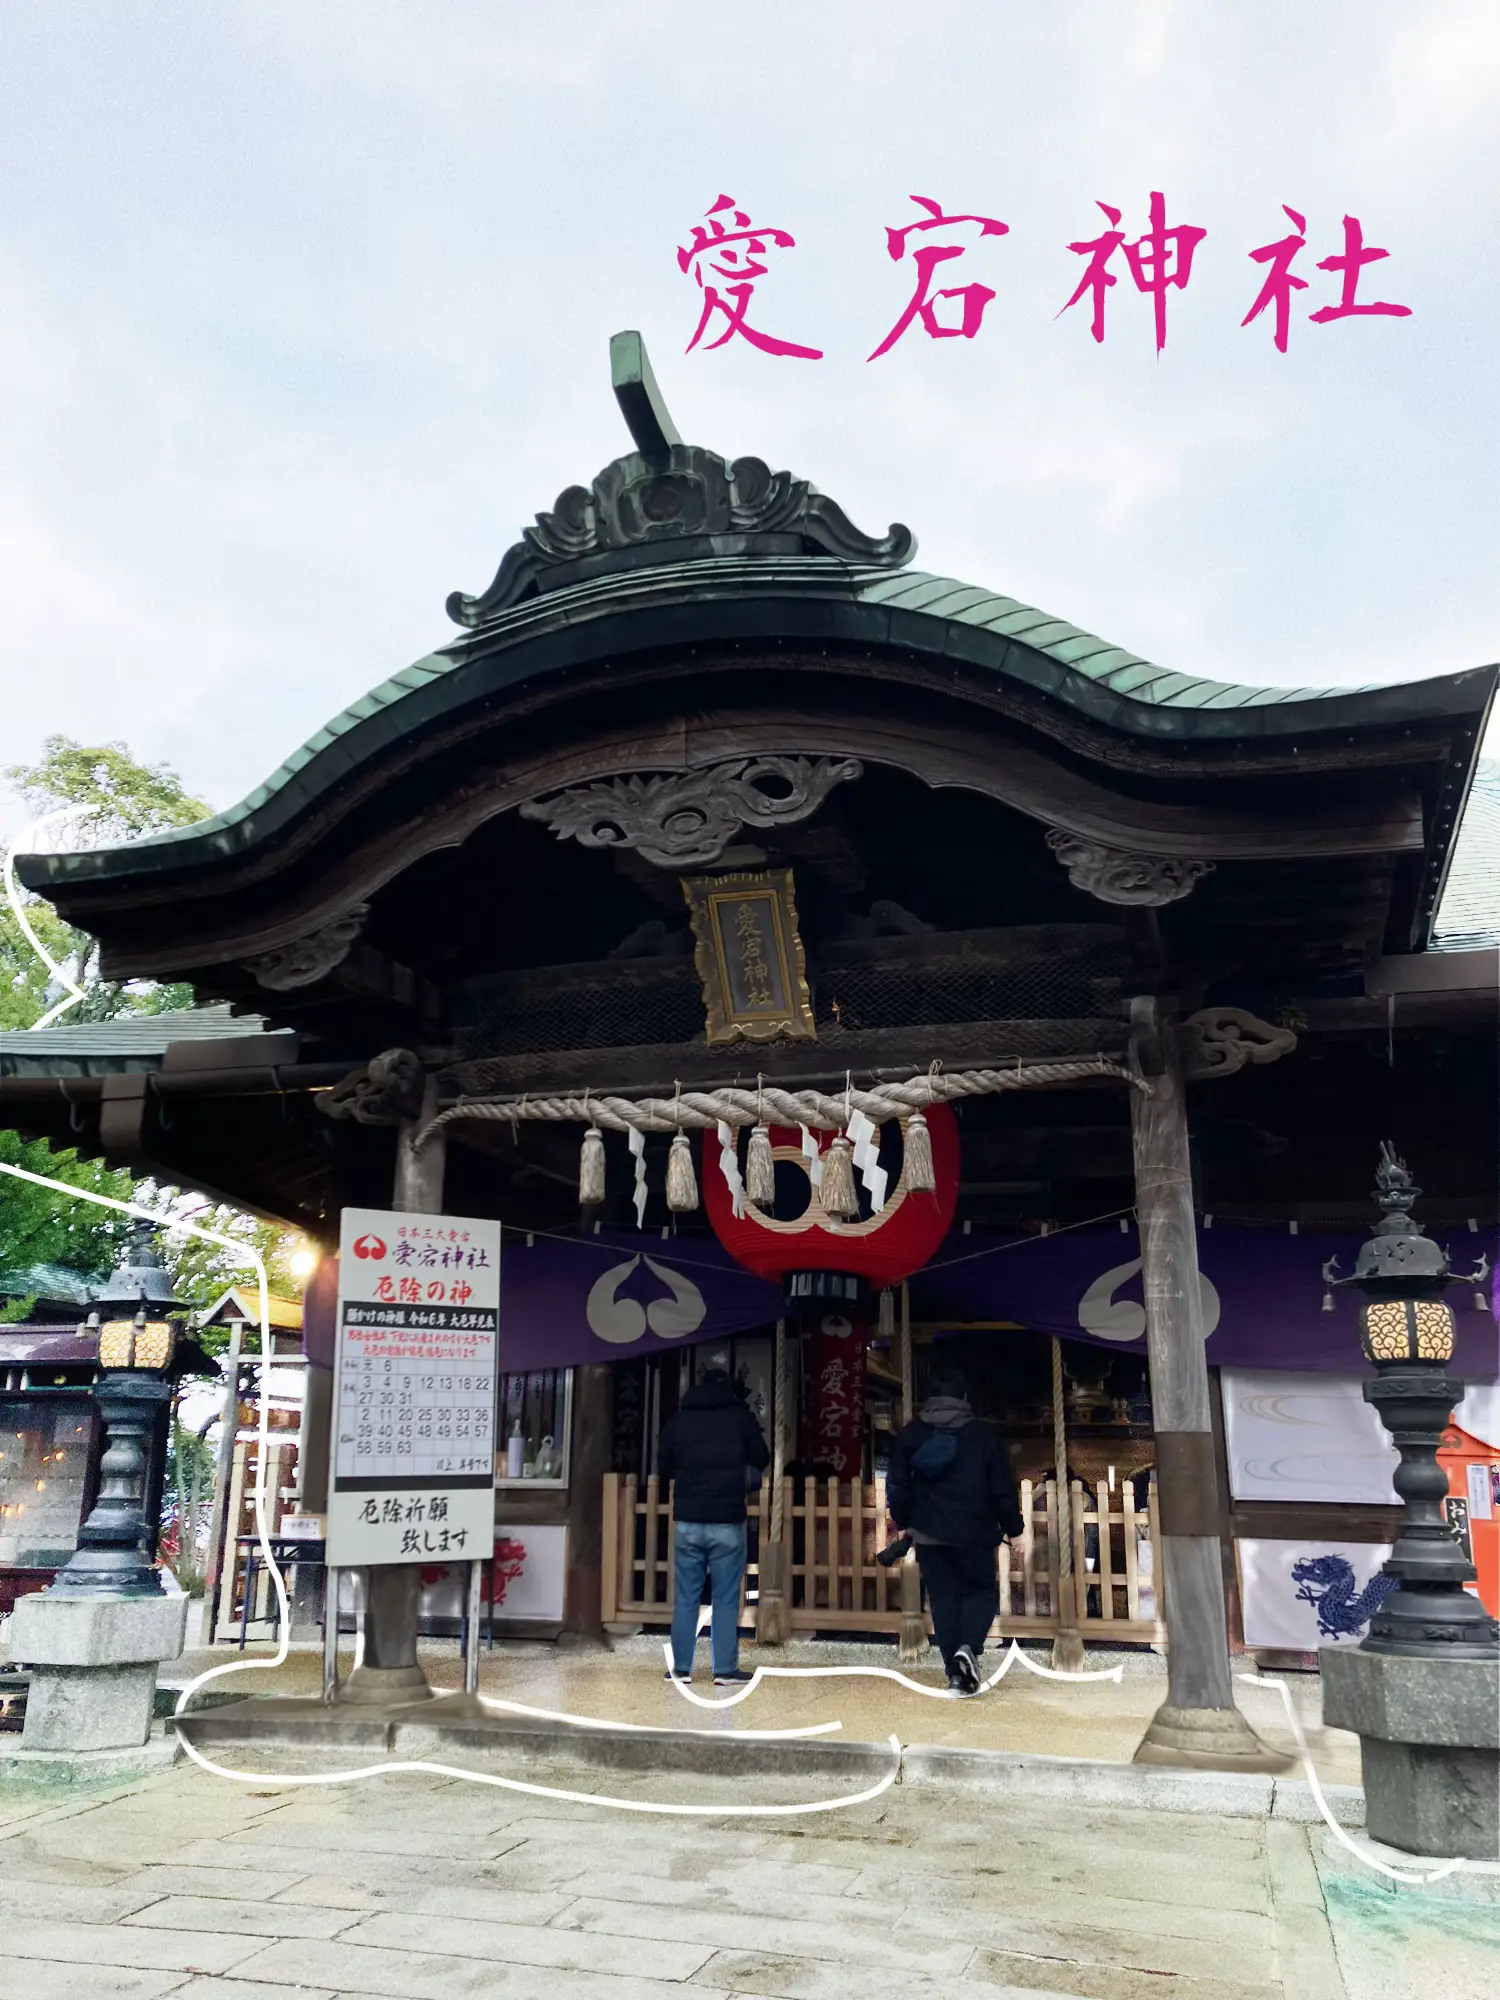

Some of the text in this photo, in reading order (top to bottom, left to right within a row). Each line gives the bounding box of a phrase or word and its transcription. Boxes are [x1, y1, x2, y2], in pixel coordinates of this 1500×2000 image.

[734, 902, 774, 1009] 愛宕神社
[392, 1240, 491, 1270] 愛宕神社
[372, 1276, 473, 1305] 厄除の神
[363, 1359, 372, 1372] 元
[384, 1360, 392, 1372] 6
[363, 1377, 371, 1389] 3
[383, 1377, 391, 1389] 4
[403, 1377, 411, 1389] 9
[420, 1377, 434, 1389] 12
[439, 1377, 453, 1389] 13
[458, 1377, 472, 1389] 18
[475, 1377, 489, 1389] 22
[359, 1392, 413, 1405] 27 30 31
[362, 1408, 489, 1421] 2 11 20 25 30 33 36
[357, 1424, 488, 1437] 39 40 45 48 49 54 57
[356, 1441, 371, 1454] 58
[377, 1441, 392, 1454] 59
[358, 1497, 449, 1524] 厄除祈願
[400, 1528, 469, 1554] 致します
